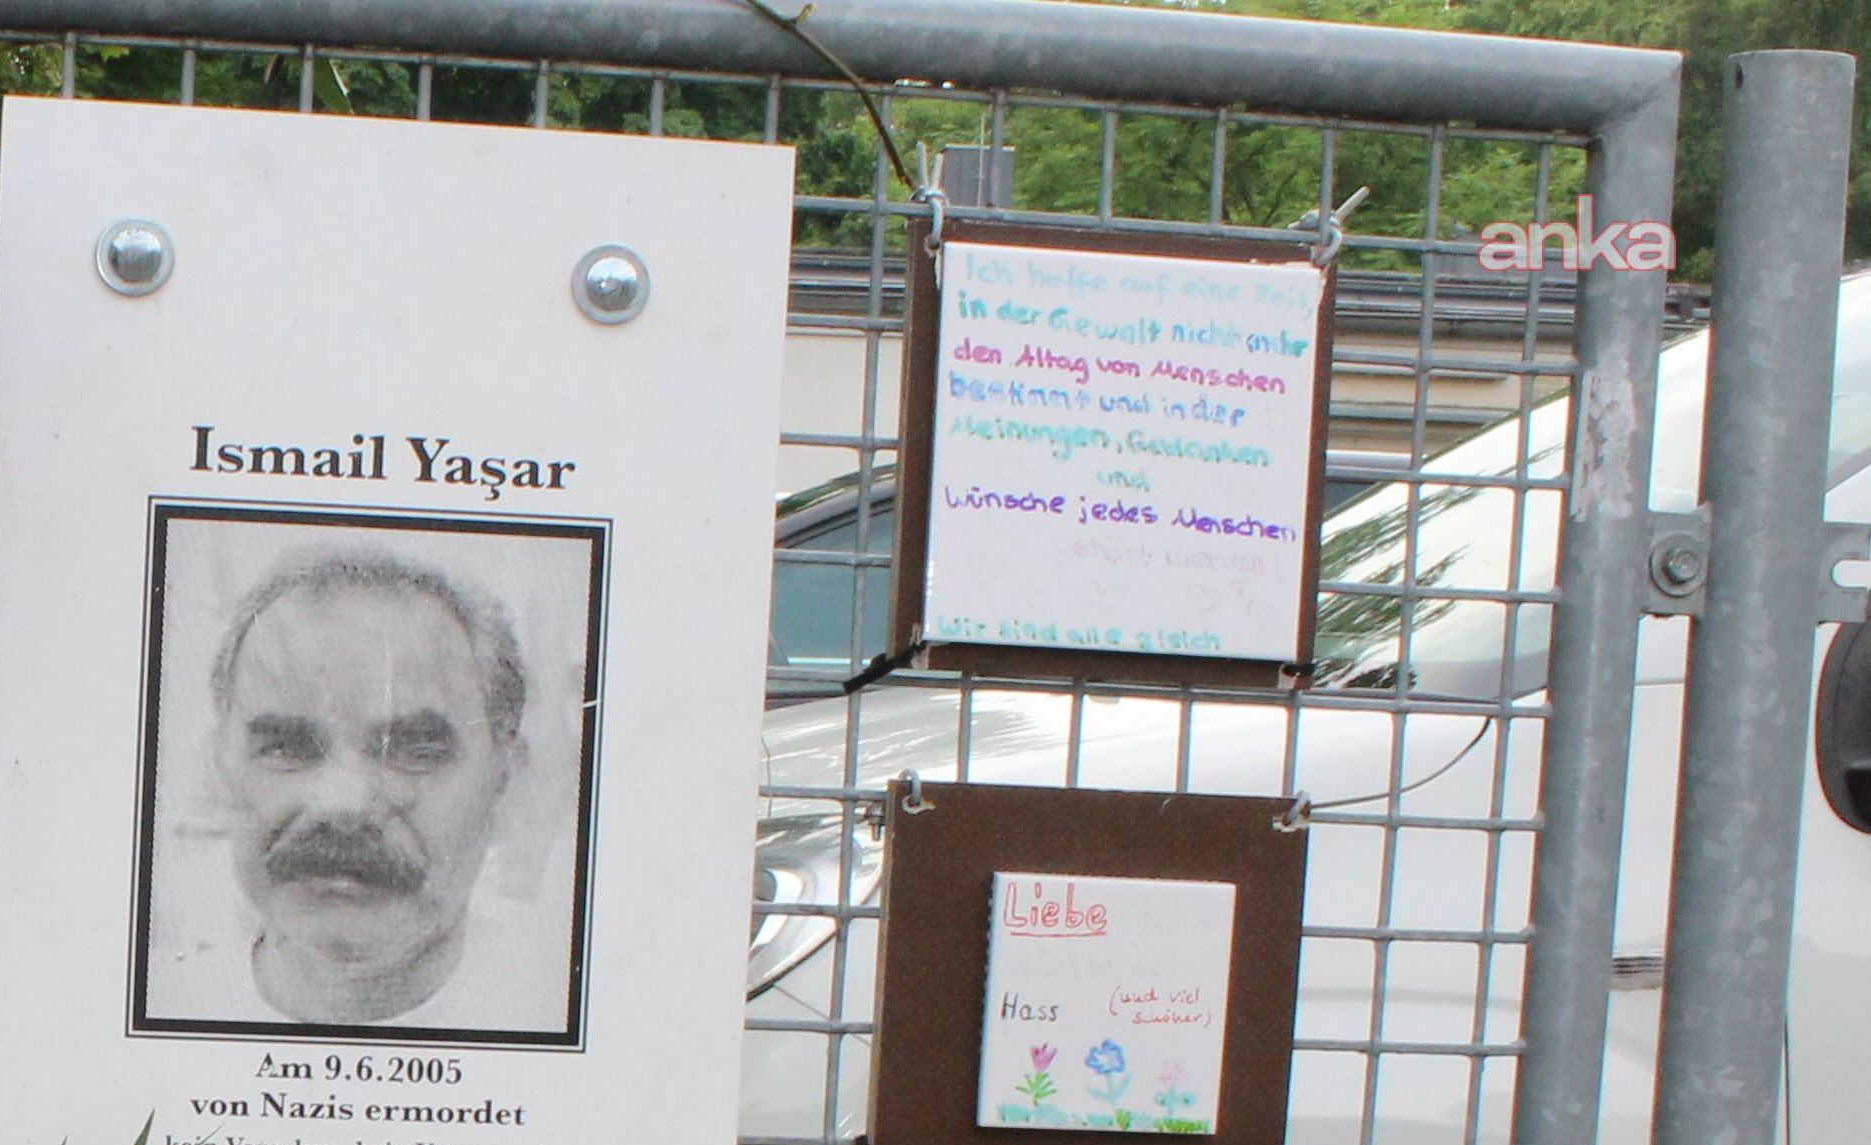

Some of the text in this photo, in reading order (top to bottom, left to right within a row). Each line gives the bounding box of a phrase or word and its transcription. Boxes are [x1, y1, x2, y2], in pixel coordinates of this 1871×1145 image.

[958, 289, 988, 319] in
[996, 298, 1042, 325] der
[1048, 306, 1161, 345] Gewalt
[953, 337, 1286, 395] den Altag von Menschen
[1099, 392, 1151, 413] und
[190, 425, 576, 501] Ismail Yaşar
[945, 486, 1297, 543] Wünsche jedes Menschen
[1003, 882, 1107, 933] Liebe
[1000, 991, 1060, 1023] Hass
[1169, 987, 1200, 1005] viel
[255, 1052, 464, 1085] Am 9.6.2005
[190, 1092, 526, 1127] von Nazis ermordet
